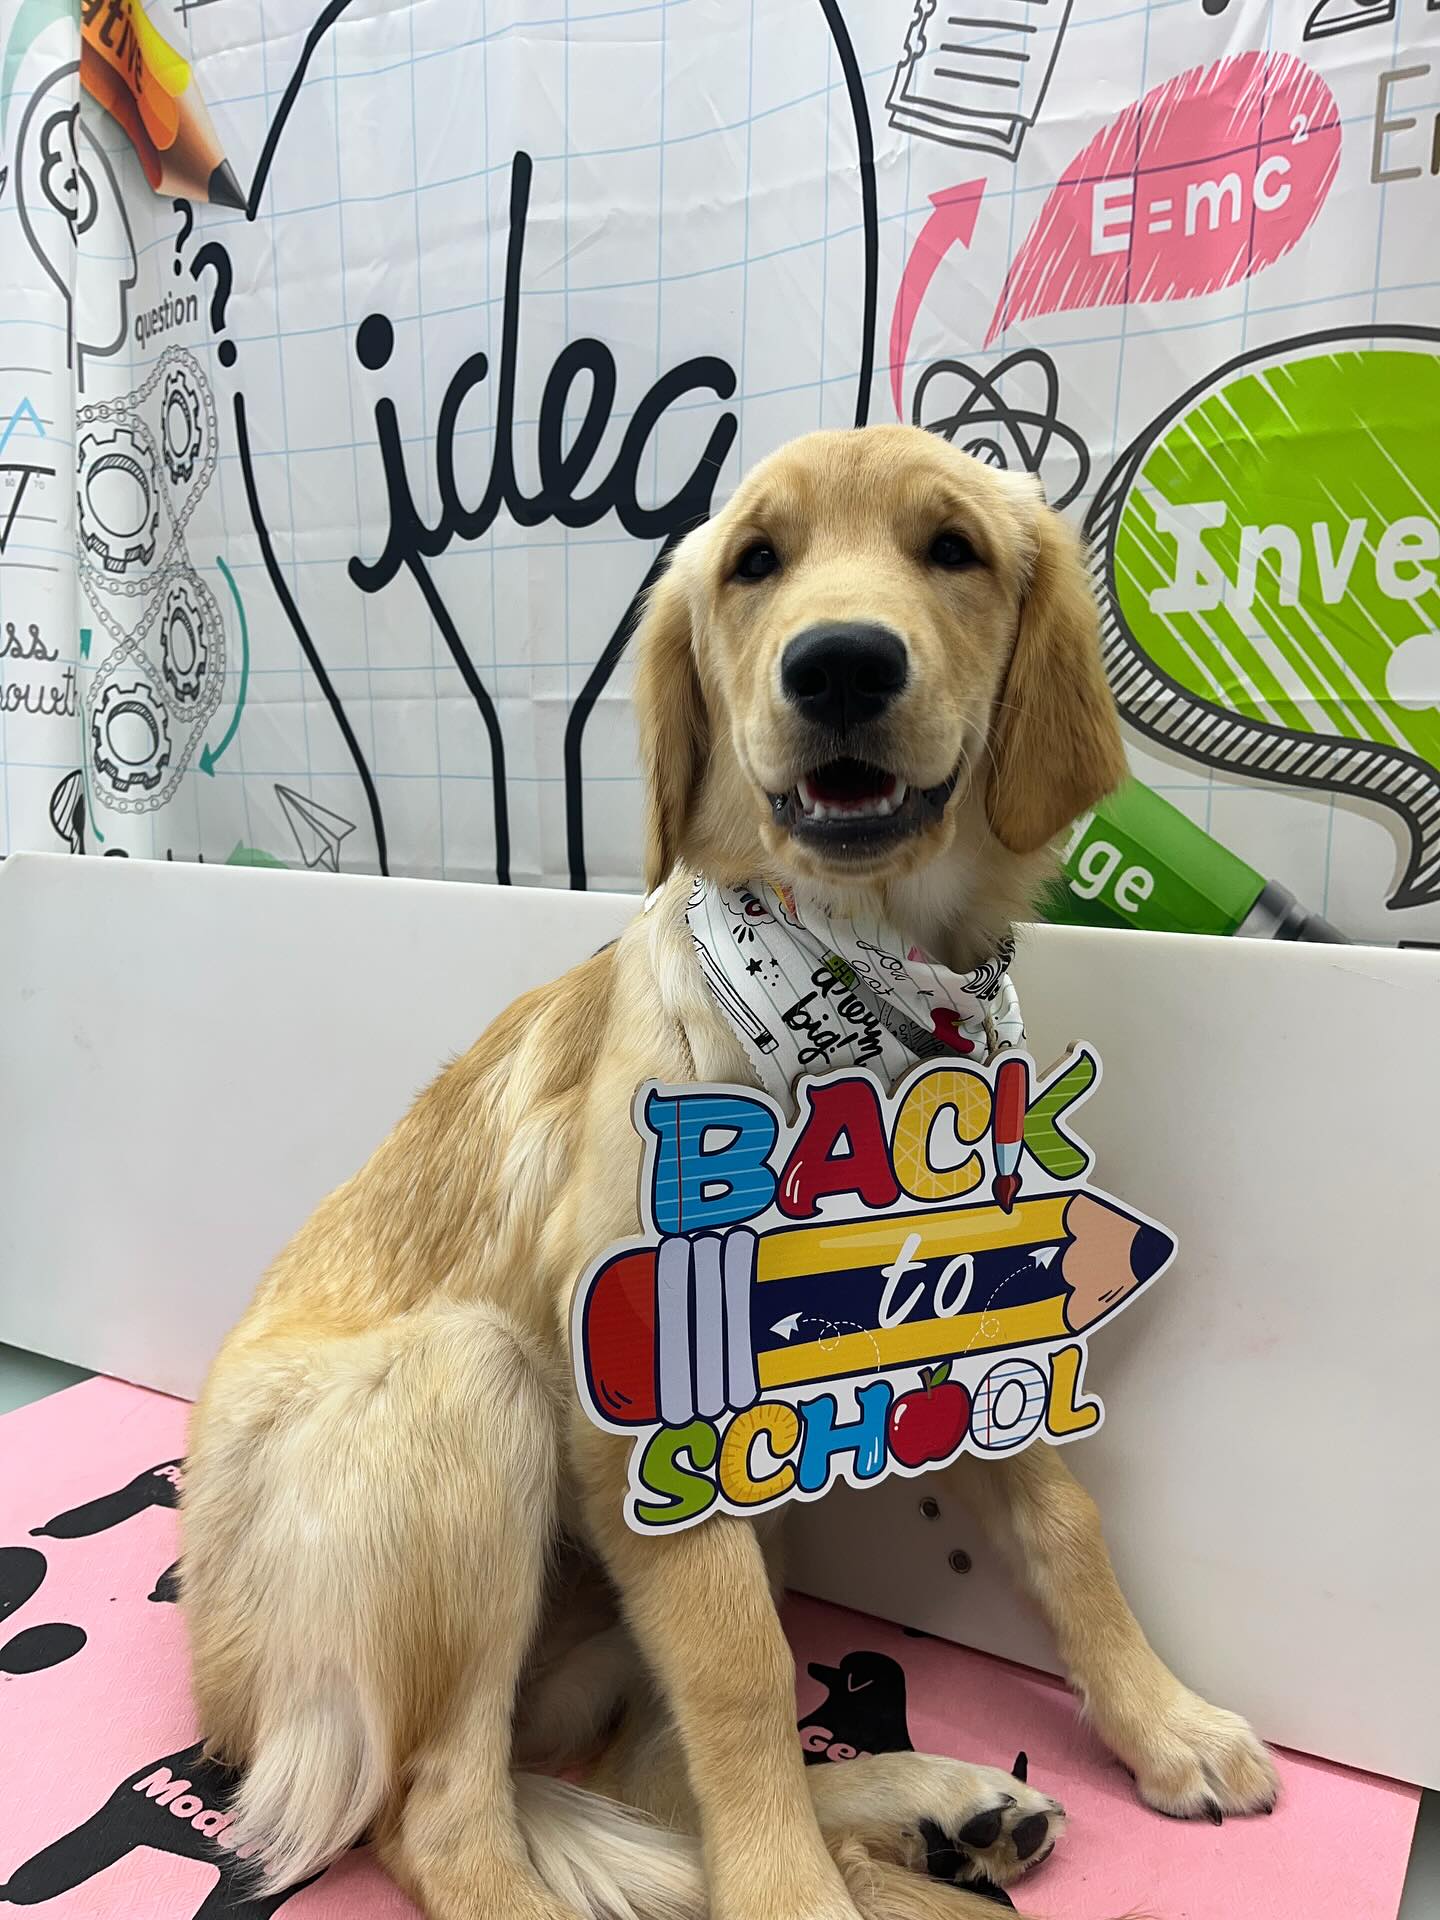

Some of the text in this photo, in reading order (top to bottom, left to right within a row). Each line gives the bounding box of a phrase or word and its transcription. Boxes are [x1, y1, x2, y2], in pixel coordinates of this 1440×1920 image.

[1370, 63, 1440, 184] E
[135, 291, 199, 349] question
[348, 150, 738, 593] idea
[1149, 500, 1440, 614] Inve
[781, 990, 841, 1065] big!
[644, 1048, 1097, 1236] BACK
[877, 1232, 975, 1329] to
[633, 1344, 1101, 1525] SCHOOL
[799, 1725, 873, 1762] Ge
